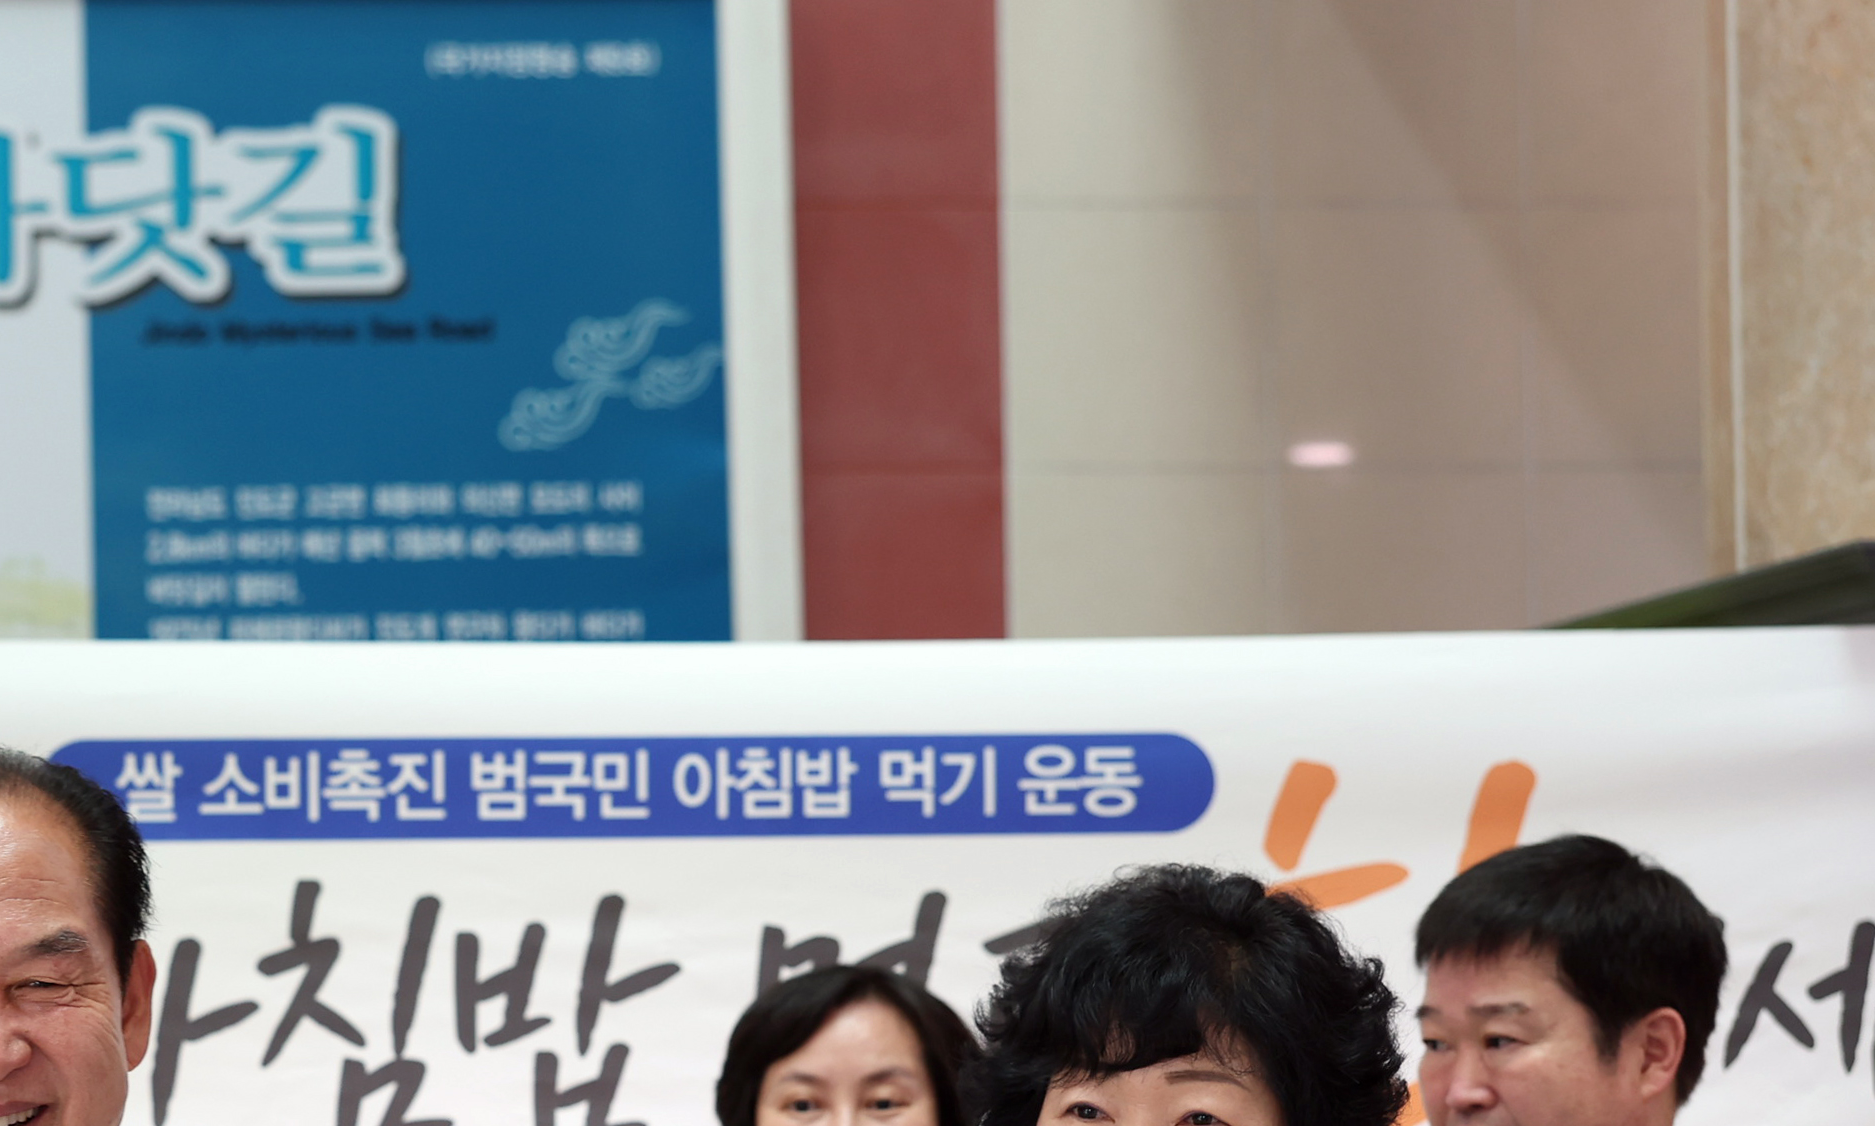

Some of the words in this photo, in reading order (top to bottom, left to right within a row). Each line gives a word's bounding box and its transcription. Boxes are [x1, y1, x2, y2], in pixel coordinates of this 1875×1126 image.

[116, 752, 181, 826] 쌀
[199, 750, 448, 824] 소비촉진
[469, 748, 651, 822] 범국민
[672, 746, 857, 821] 아침밥
[878, 744, 998, 819] 먹기
[1017, 744, 1143, 819] 운동
